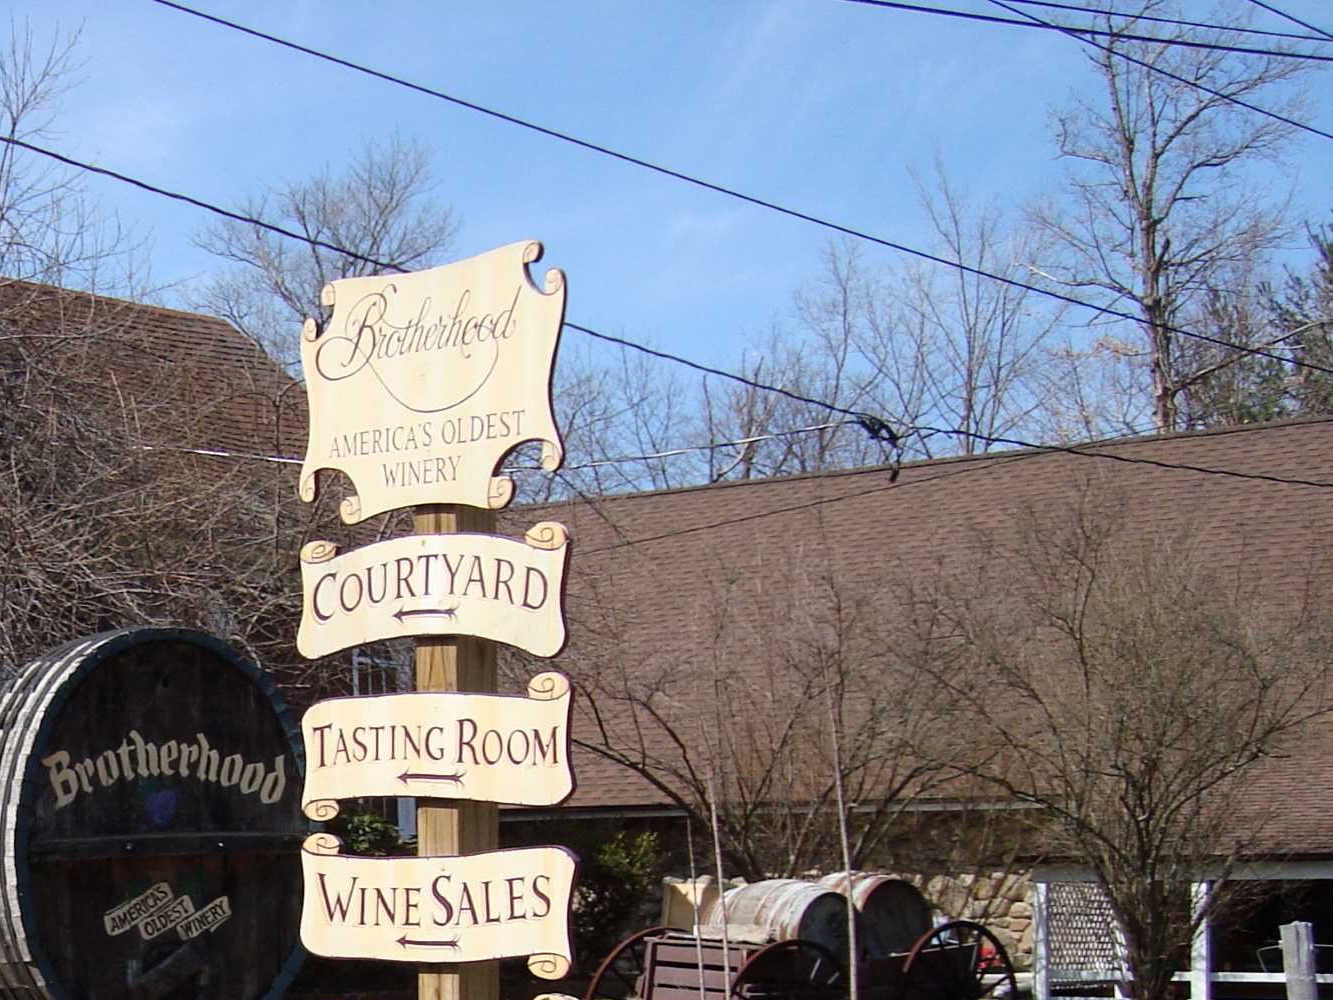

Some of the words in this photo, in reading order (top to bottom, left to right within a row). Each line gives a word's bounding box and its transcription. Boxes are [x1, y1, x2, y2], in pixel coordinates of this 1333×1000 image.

[316, 284, 522, 380] Brotherhood
[330, 422, 432, 459] AMERICA'S
[441, 410, 525, 445] OLDEST
[382, 456, 462, 488] WINERY
[313, 554, 548, 622] COURTYARD
[313, 723, 446, 768] TASTING
[456, 718, 559, 766] ROOM
[42, 730, 286, 809] Brotherhood
[143, 899, 190, 936] OLDEST
[179, 900, 227, 936] WINERY
[317, 872, 421, 927] WINE
[431, 874, 551, 927] SALES
